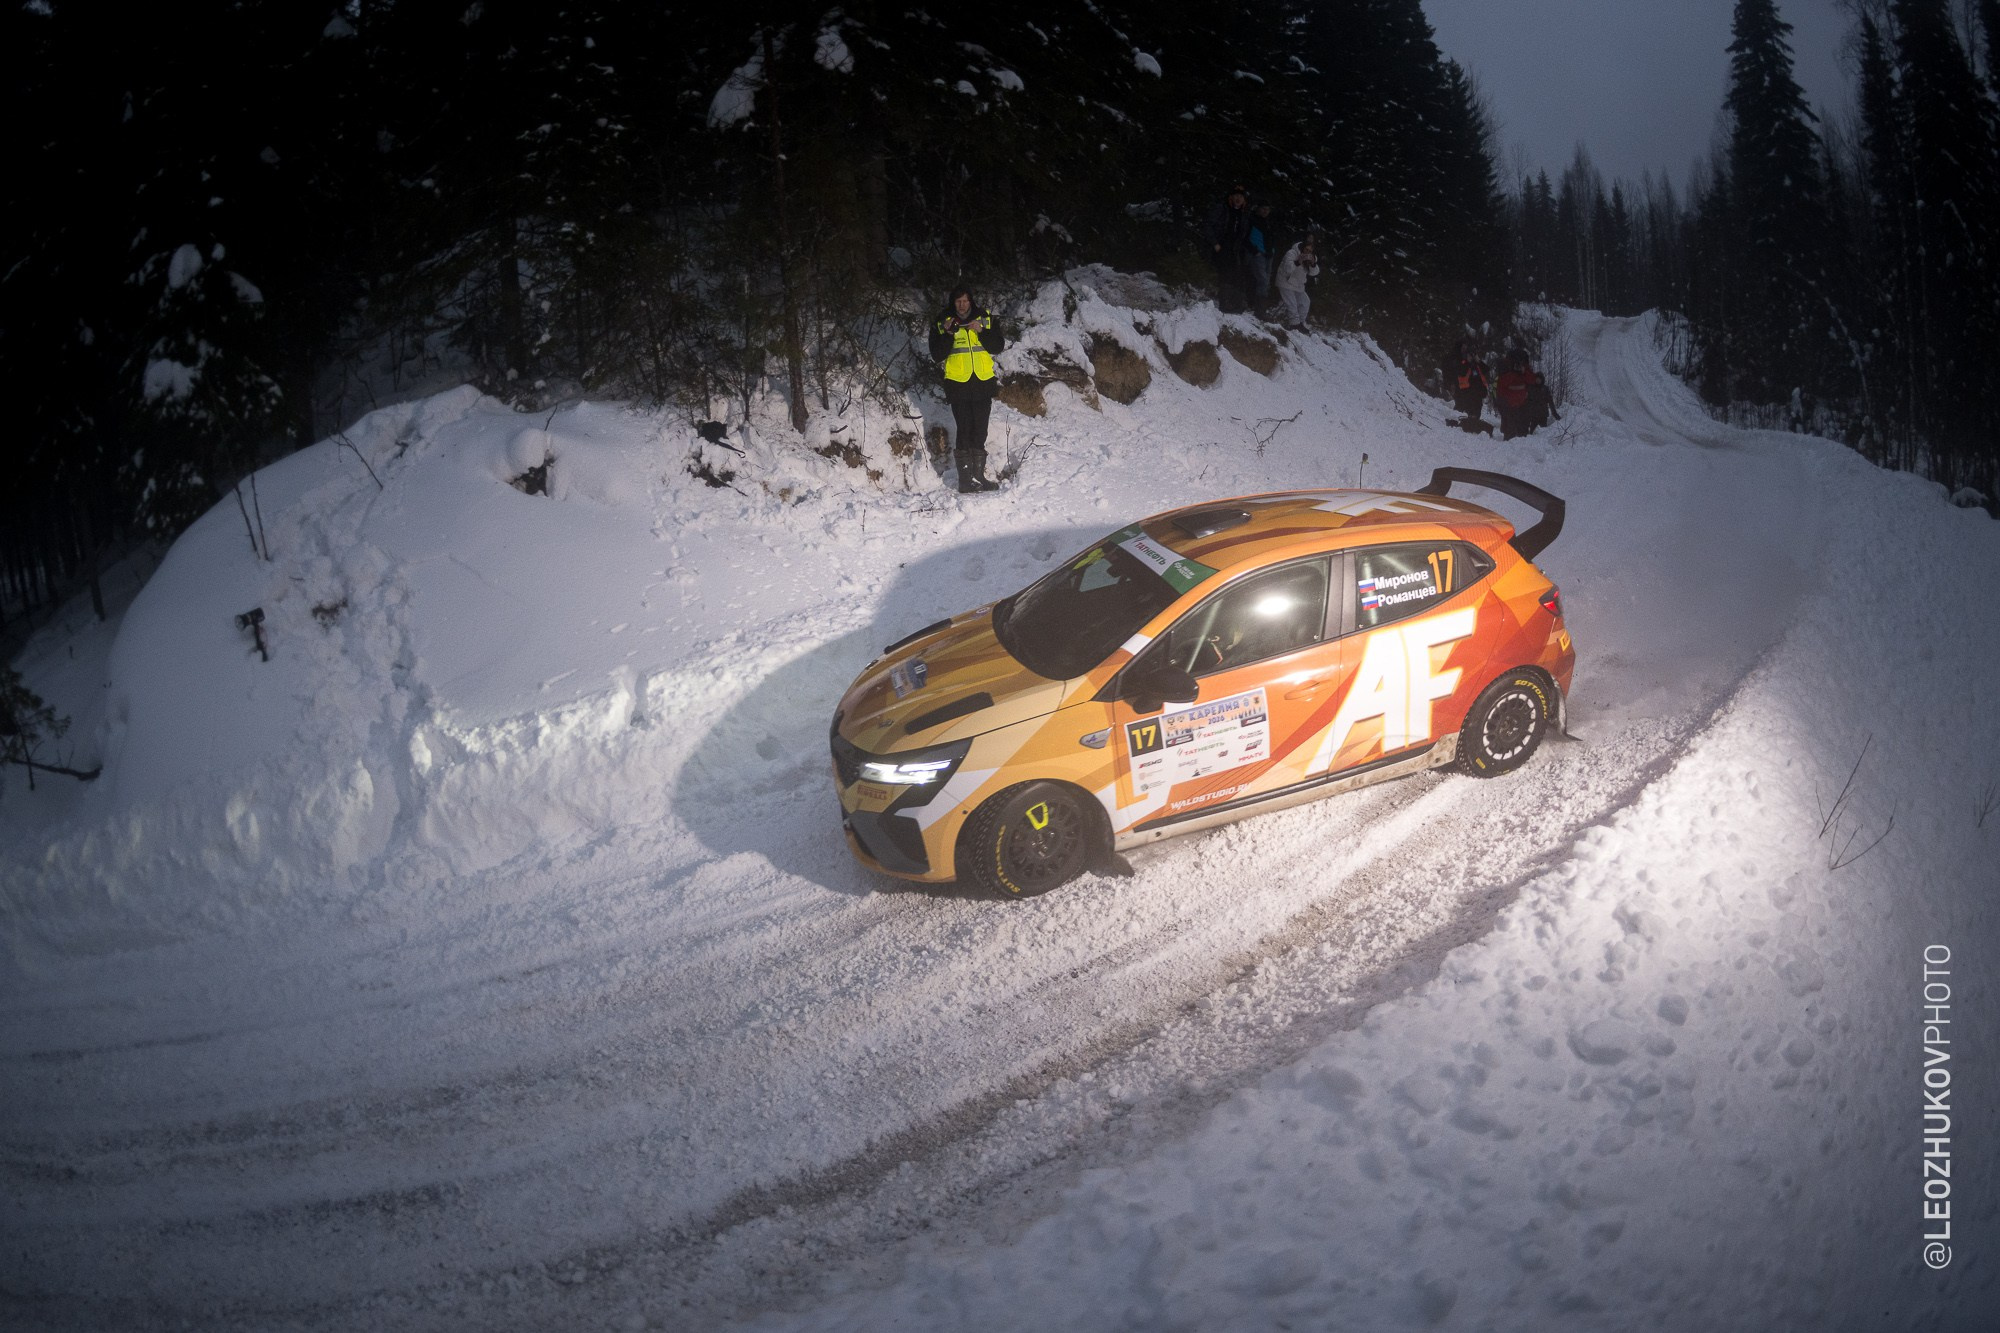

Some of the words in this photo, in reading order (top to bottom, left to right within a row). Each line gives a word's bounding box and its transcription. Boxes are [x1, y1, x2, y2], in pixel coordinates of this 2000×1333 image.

[1134, 541, 1166, 566] ТАТНЕФТЬ
[1374, 570, 1429, 590] Миронов
[1427, 549, 1453, 594] 17
[1377, 586, 1436, 607] Романцев
[1304, 607, 1476, 779] AF
[1188, 700, 1240, 721] КАРЕЛИЯ
[1207, 715, 1225, 725] 2026
[1131, 725, 1157, 750] 17
[1171, 783, 1253, 811] WALDSTUDIO.RU
